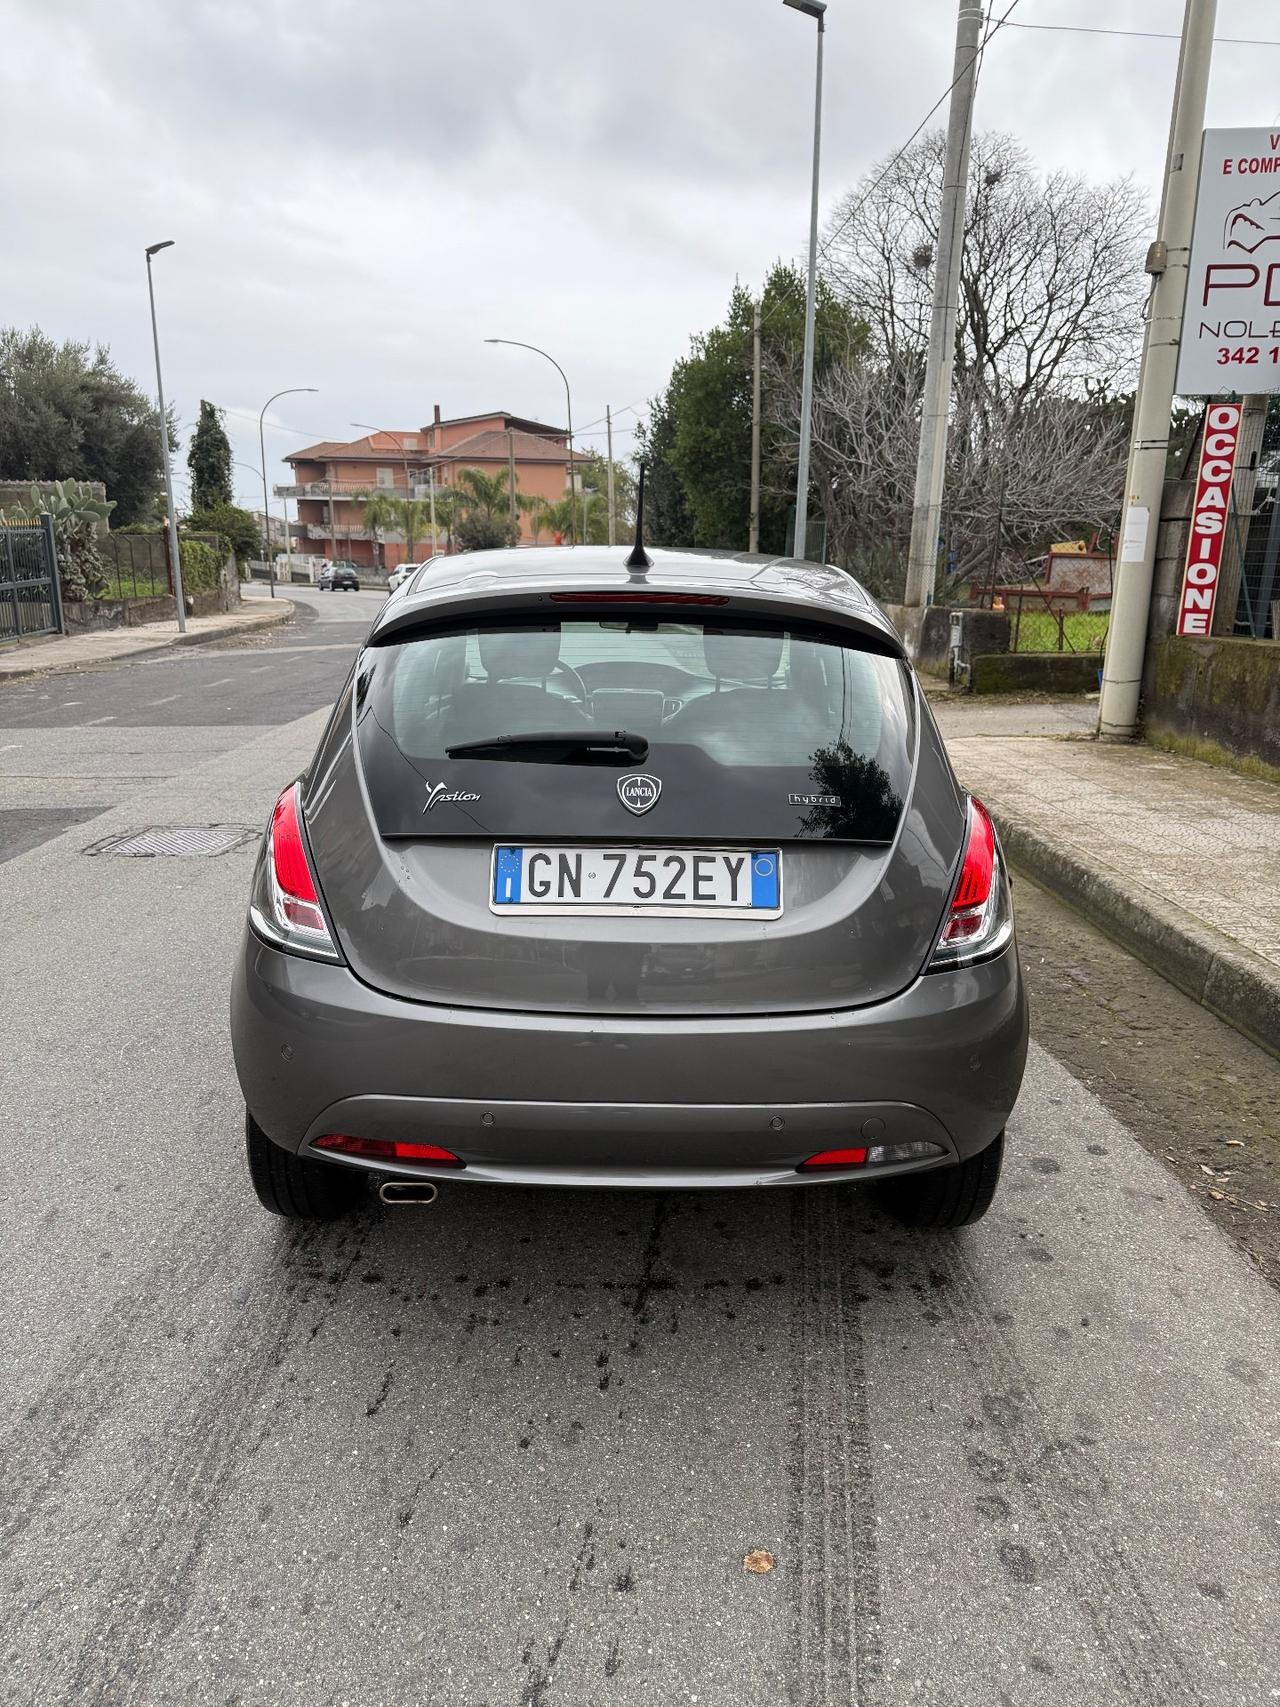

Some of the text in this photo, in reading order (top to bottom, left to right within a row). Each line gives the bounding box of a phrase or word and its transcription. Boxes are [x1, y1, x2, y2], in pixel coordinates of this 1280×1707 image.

[1223, 158, 1233, 174] E
[1217, 346, 1279, 365] 342 1
[1182, 406, 1240, 635] OCCASIONE
[422, 780, 481, 814] Ypsilon
[626, 787, 653, 797] LANCIA
[794, 794, 836, 804] hybrid
[528, 852, 745, 901] GN 752EY
